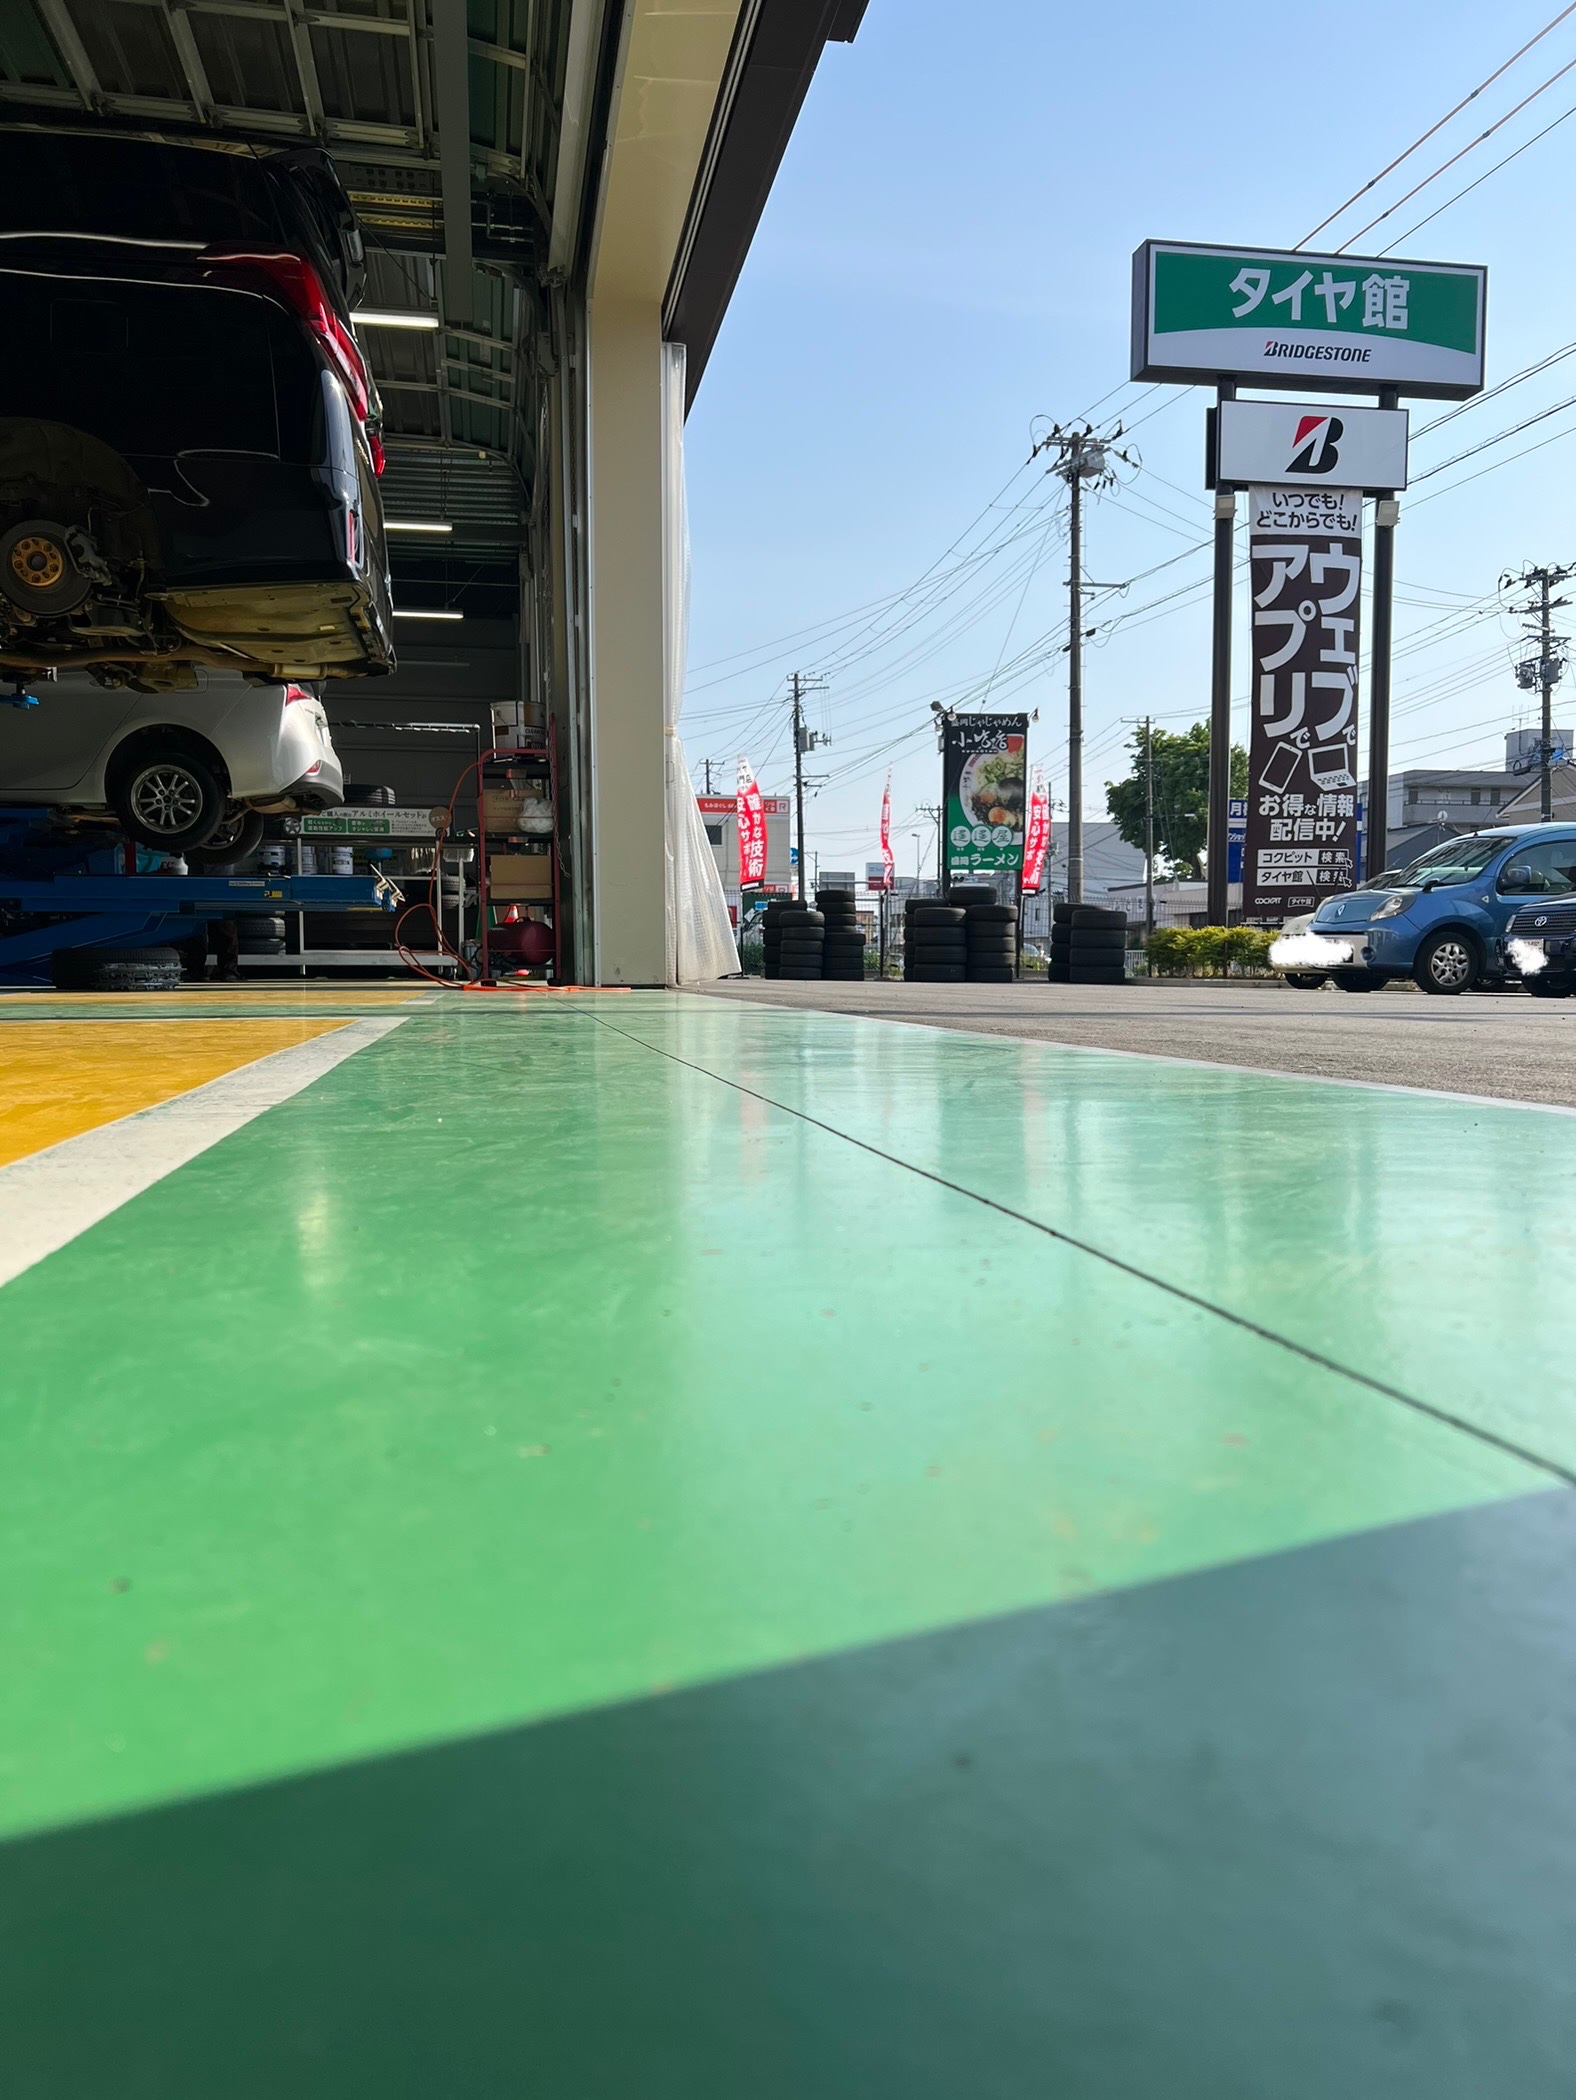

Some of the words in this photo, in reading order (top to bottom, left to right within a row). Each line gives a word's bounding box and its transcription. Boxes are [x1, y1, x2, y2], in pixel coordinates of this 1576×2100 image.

[1229, 267, 1410, 330] タイヤ館
[1263, 341, 1372, 363] BRIDGESTONE
[1259, 794, 1354, 817] お得な情報
[745, 793, 764, 878] 確かな技術
[1269, 818, 1347, 842] 配信中!
[1262, 851, 1312, 863] コクピット
[1321, 851, 1346, 863] 検索
[1261, 870, 1304, 882] タイヤ館
[1254, 897, 1282, 905] COCKPIT
